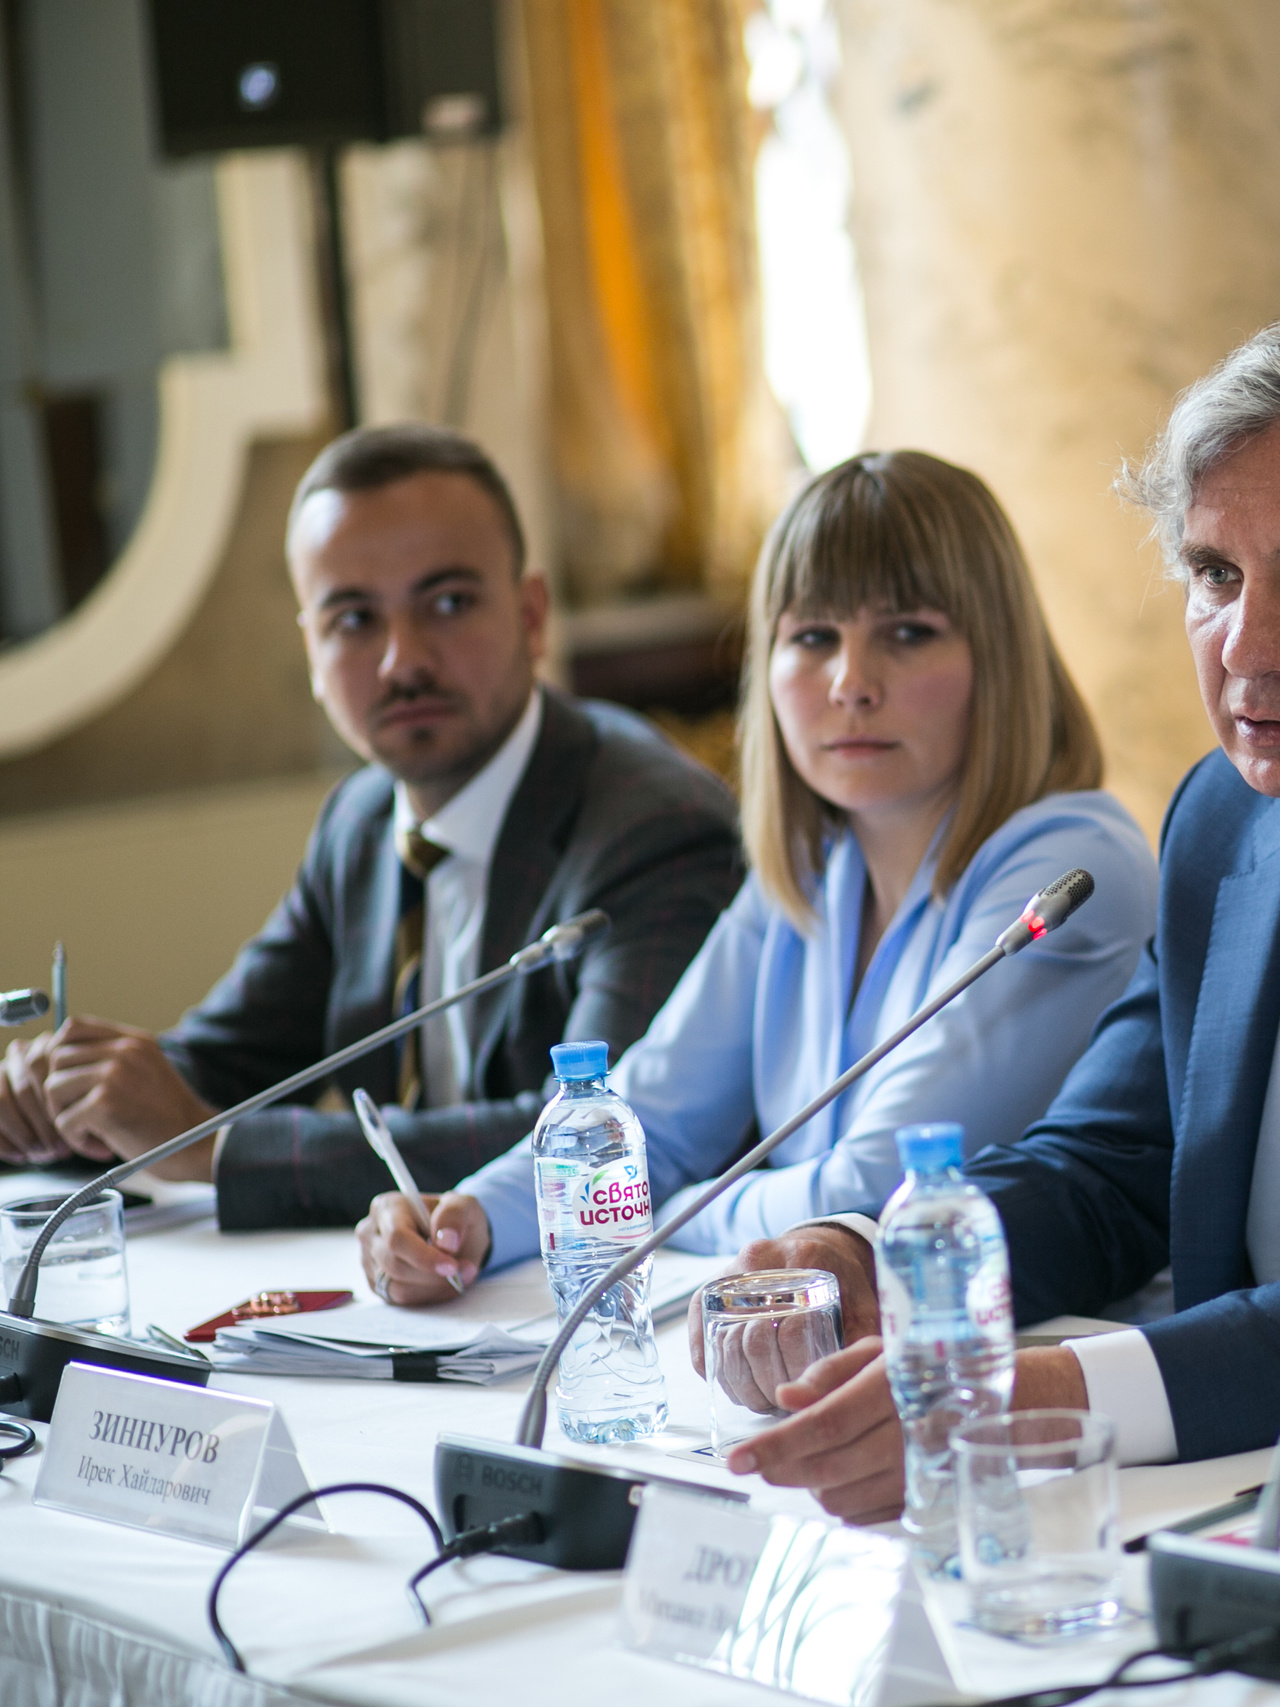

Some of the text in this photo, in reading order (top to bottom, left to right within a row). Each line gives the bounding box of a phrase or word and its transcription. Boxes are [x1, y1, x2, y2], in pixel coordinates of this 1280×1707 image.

[89, 1410, 220, 1464] ЗИННУРОВ
[77, 1455, 211, 1506] Ирек Хайдарович
[681, 1543, 759, 1589] ДРО
